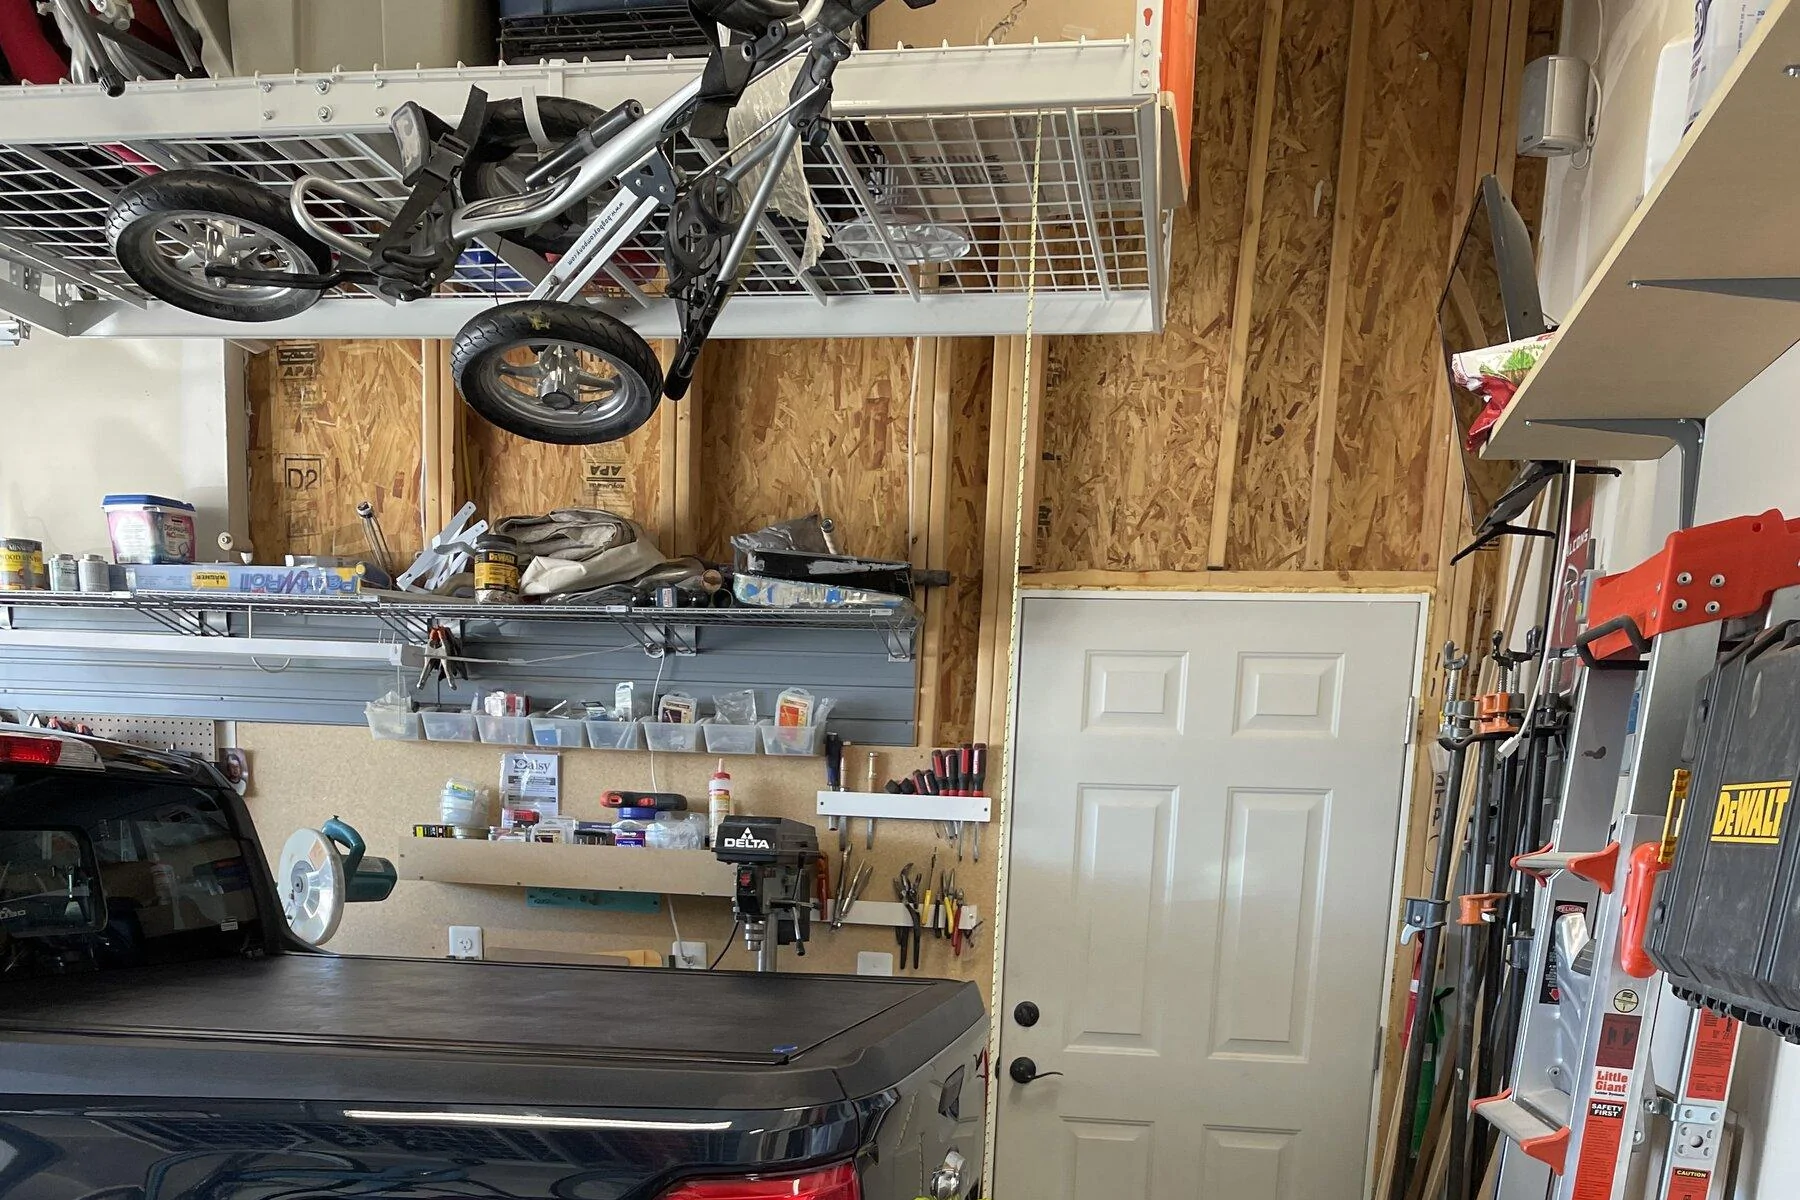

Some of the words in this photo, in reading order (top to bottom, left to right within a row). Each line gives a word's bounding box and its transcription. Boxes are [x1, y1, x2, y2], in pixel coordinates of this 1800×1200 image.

[567, 201, 624, 266] www.bagboycompany.com
[284, 366, 314, 377] APA
[590, 465, 622, 476] APA
[287, 468, 318, 490] D2
[724, 838, 770, 849] DELTA
[1597, 1070, 1628, 1083] Little
[1595, 1081, 1626, 1093] Giant
[1591, 1103, 1623, 1112] SAFETY
[1594, 1109, 1619, 1117] FIRST
[1676, 1169, 1707, 1178] CAUTION
